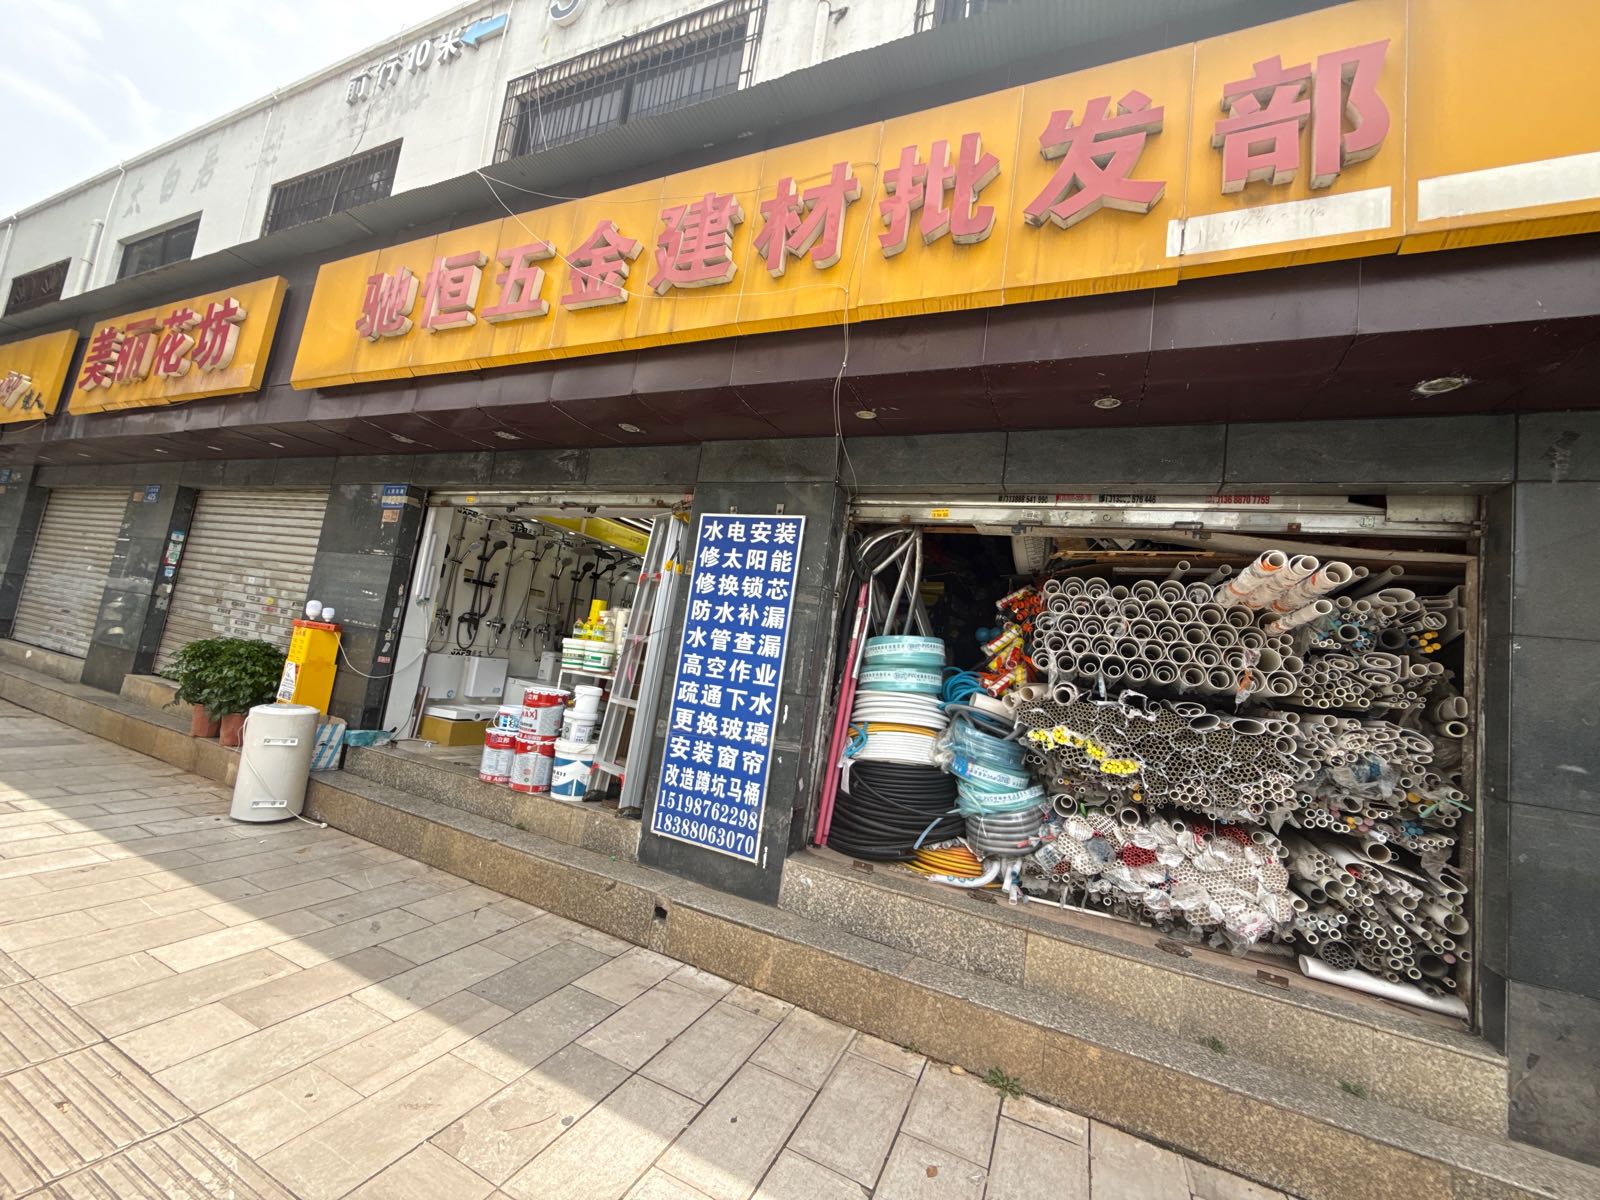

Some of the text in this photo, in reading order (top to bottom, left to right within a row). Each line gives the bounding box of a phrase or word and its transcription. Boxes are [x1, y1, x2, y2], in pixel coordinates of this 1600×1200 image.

[346, 27, 464, 106] 前行10米
[356, 38, 1392, 343] 驰恒五金建材批发部
[78, 297, 248, 392] 美丽花坊
[703, 520, 798, 545] 水电安装
[699, 546, 793, 573] 修太阳能
[695, 572, 790, 601] 修换锁芯
[691, 599, 786, 629] 防水补漏
[686, 626, 782, 659] 水管查漏
[682, 653, 777, 687] 高空作业
[677, 680, 773, 716] 疏通下水
[672, 707, 770, 748] 更换玻璃
[669, 736, 765, 775] 安装窗帘
[664, 763, 761, 807] 改造蹲坑马桶
[658, 789, 758, 831] 15198762298
[655, 812, 755, 855] 18388063070
